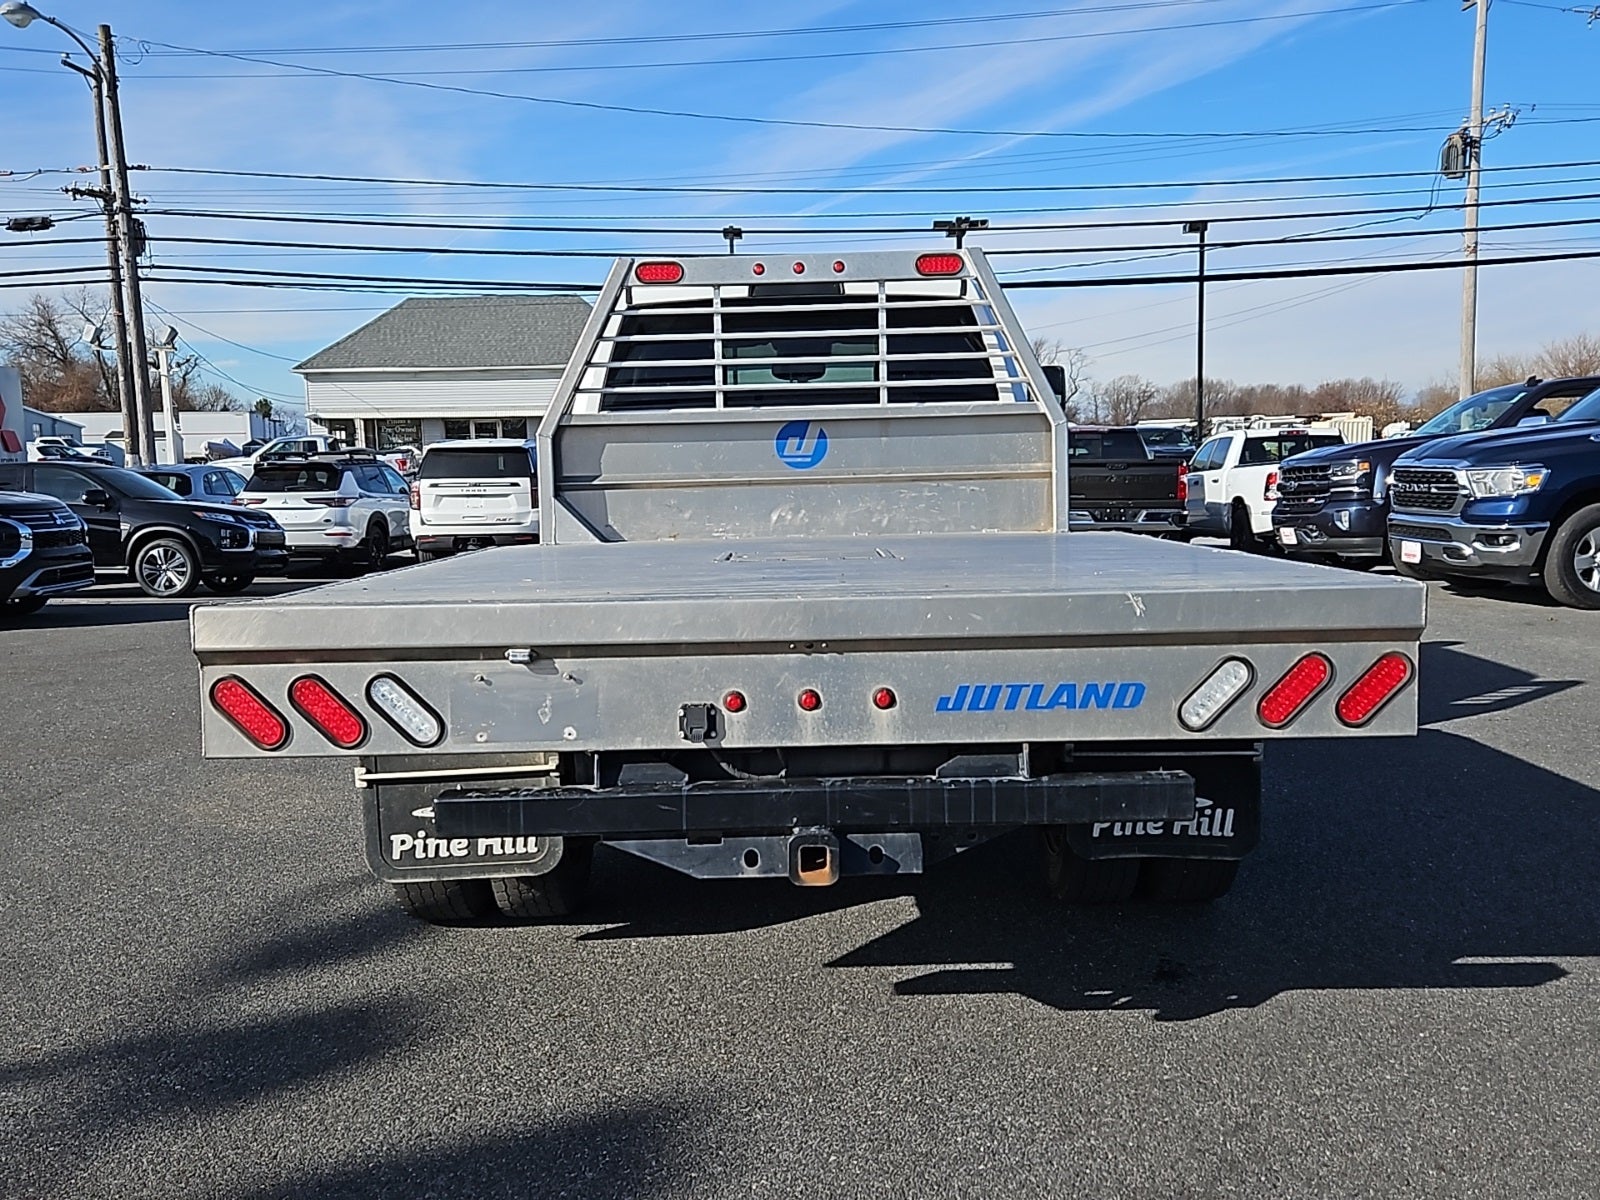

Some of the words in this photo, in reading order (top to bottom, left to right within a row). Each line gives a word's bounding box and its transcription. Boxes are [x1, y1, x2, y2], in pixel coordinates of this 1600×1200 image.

[1400, 483, 1429, 492] RAM
[935, 682, 1147, 712] JUTLAND
[389, 830, 469, 860] Pine
